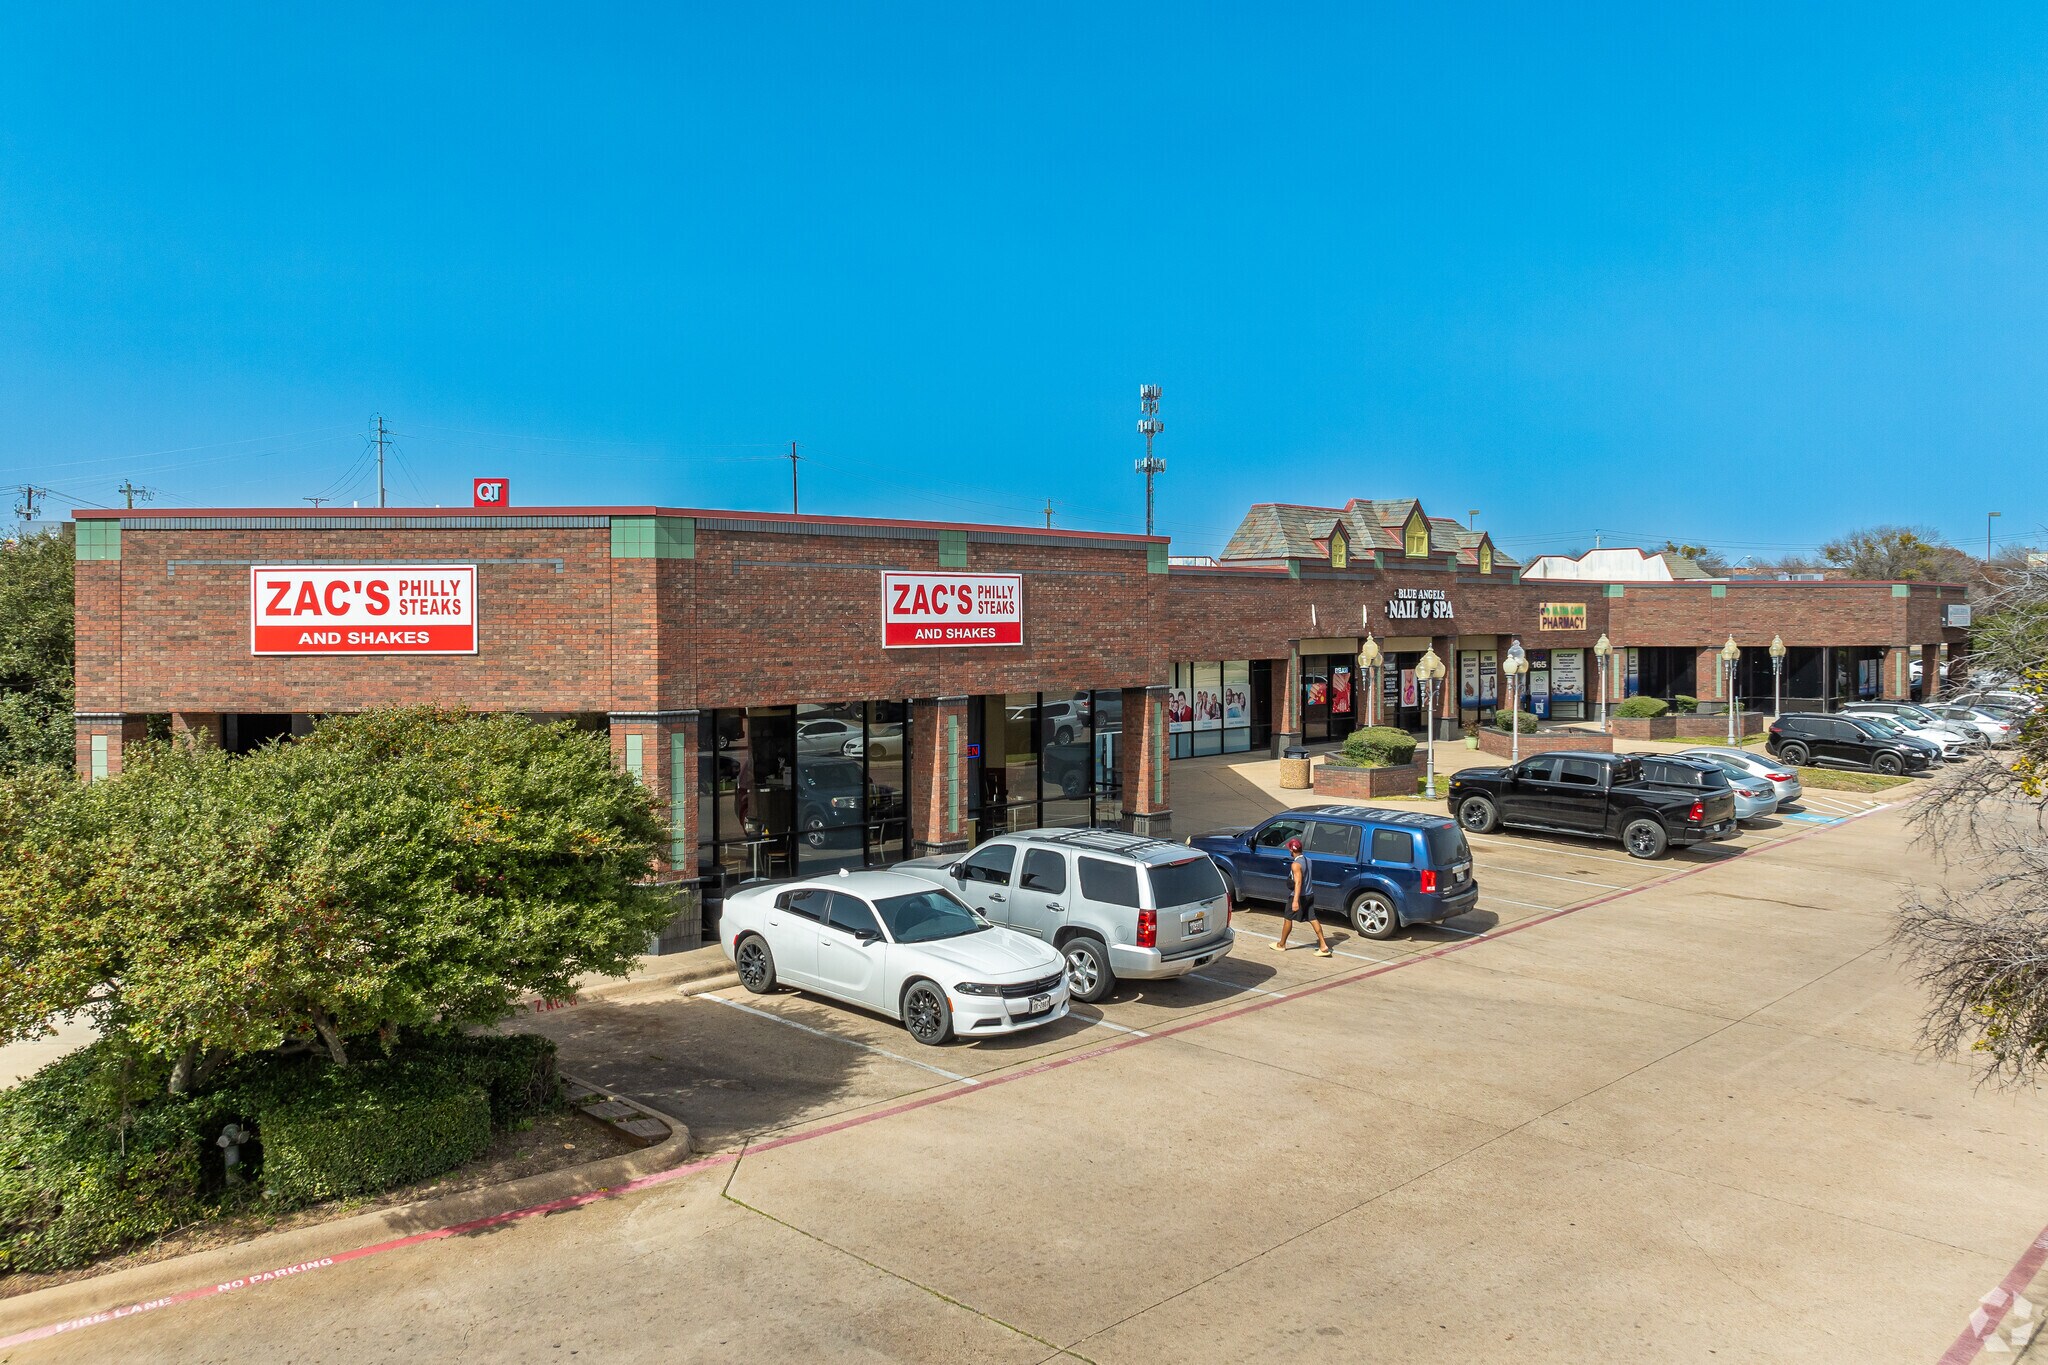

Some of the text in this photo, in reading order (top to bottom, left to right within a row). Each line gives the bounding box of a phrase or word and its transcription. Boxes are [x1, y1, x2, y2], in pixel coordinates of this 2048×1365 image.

[477, 483, 502, 502] QT
[399, 580, 461, 597] PHILLY
[977, 585, 1014, 599] PHILLY
[1398, 588, 1445, 600] BLUE ANGELS
[265, 580, 391, 616] ZAC'S
[893, 584, 973, 615] ZAC'S
[399, 598, 462, 616] STEAKS
[978, 601, 1015, 614] STEAKS
[1389, 600, 1454, 619] NAIL & SPA
[1542, 616, 1584, 629] PHARMACY
[298, 631, 430, 645] AND SHAKES
[915, 628, 996, 639] AND SHAKES
[56, 1258, 334, 1333] FIRE LANE NO PARKING
